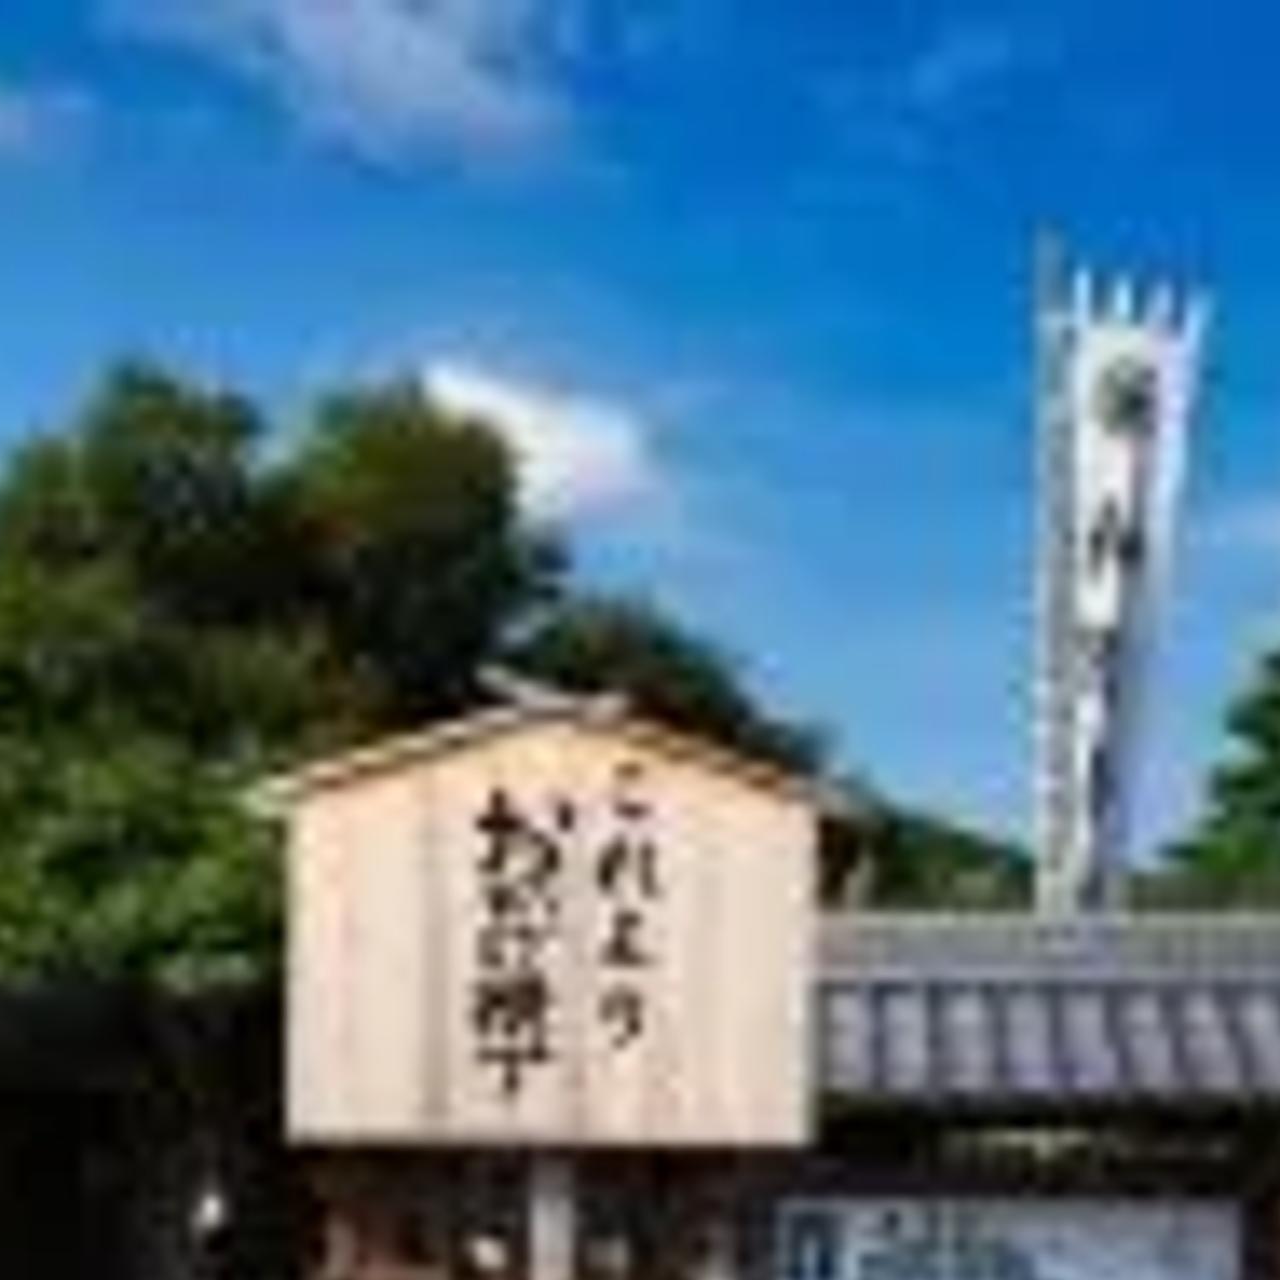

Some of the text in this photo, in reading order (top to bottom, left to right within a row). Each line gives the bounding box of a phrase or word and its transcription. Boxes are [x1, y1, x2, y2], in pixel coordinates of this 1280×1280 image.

[471, 787, 576, 1096] おかげ横丁
[597, 760, 660, 1052] これより
